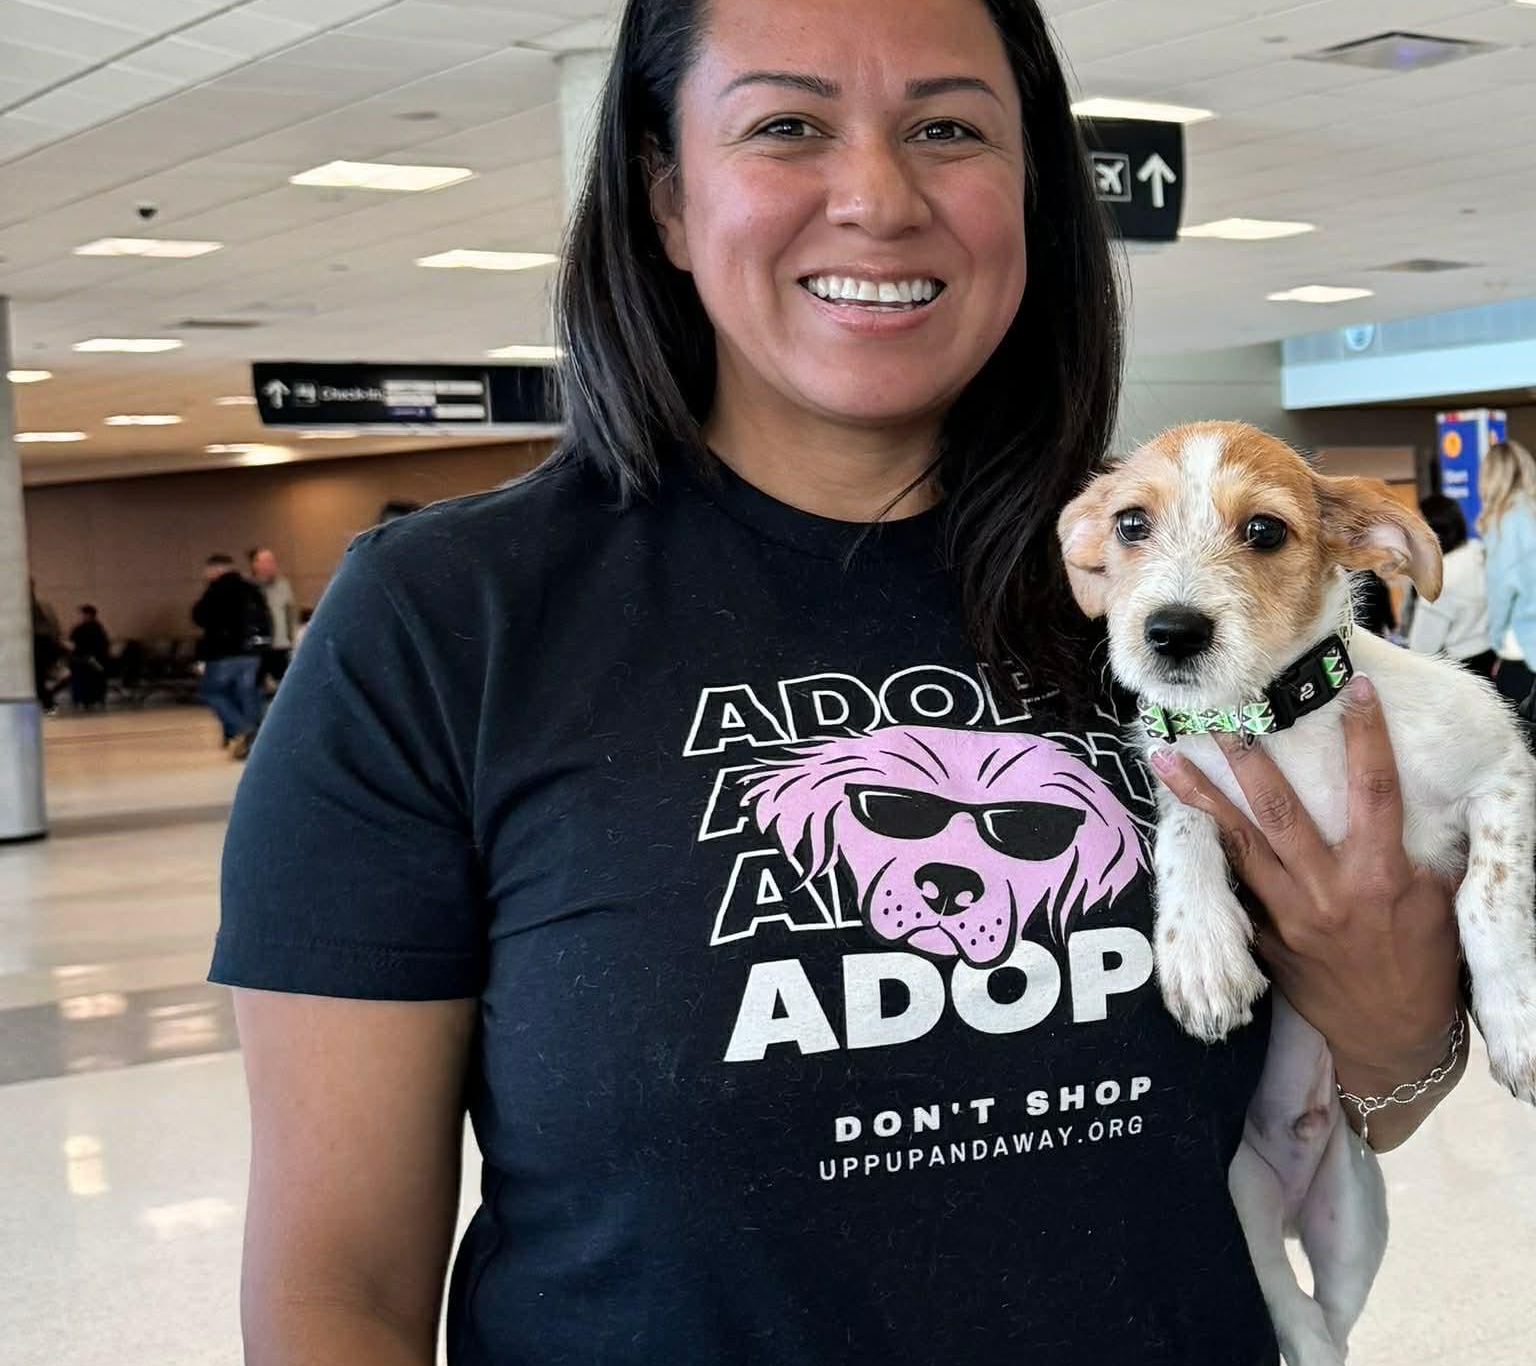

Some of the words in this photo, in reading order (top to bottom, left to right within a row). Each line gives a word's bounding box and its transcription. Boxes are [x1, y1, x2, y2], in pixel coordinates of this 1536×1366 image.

[682, 664, 1121, 757] ADOP
[723, 927, 1153, 1062] ADOP
[818, 1115, 1144, 1181] UPPUPANDAWAY.ORG
[834, 1098, 996, 1143] DON'T
[1026, 1076, 1152, 1116] SHOP
